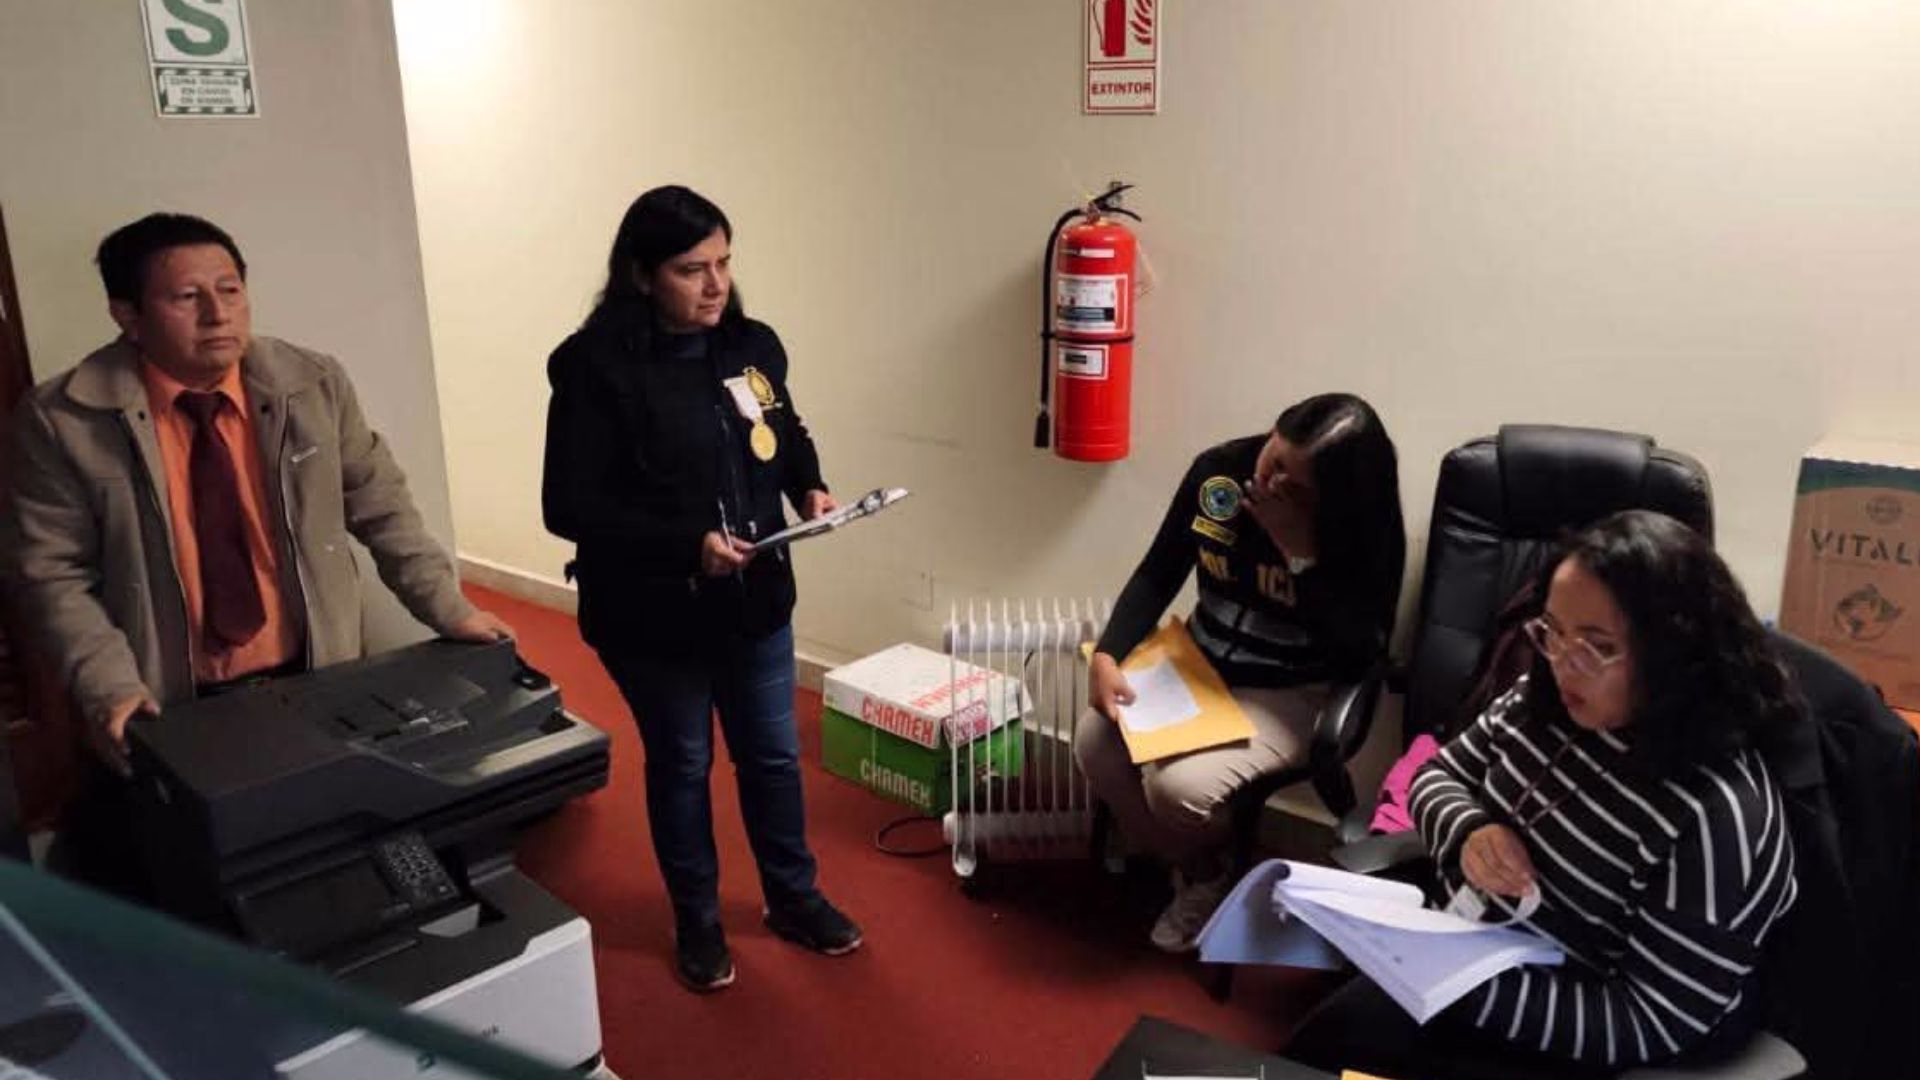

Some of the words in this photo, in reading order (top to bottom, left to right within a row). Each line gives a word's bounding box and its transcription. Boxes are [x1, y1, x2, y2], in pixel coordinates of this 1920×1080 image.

[161, 0, 230, 57] S
[1091, 82, 1152, 95] EXTINTOR
[1810, 528, 1920, 567] VITAL
[861, 696, 935, 746] CHAMEX
[859, 758, 932, 807] CHAMEX
